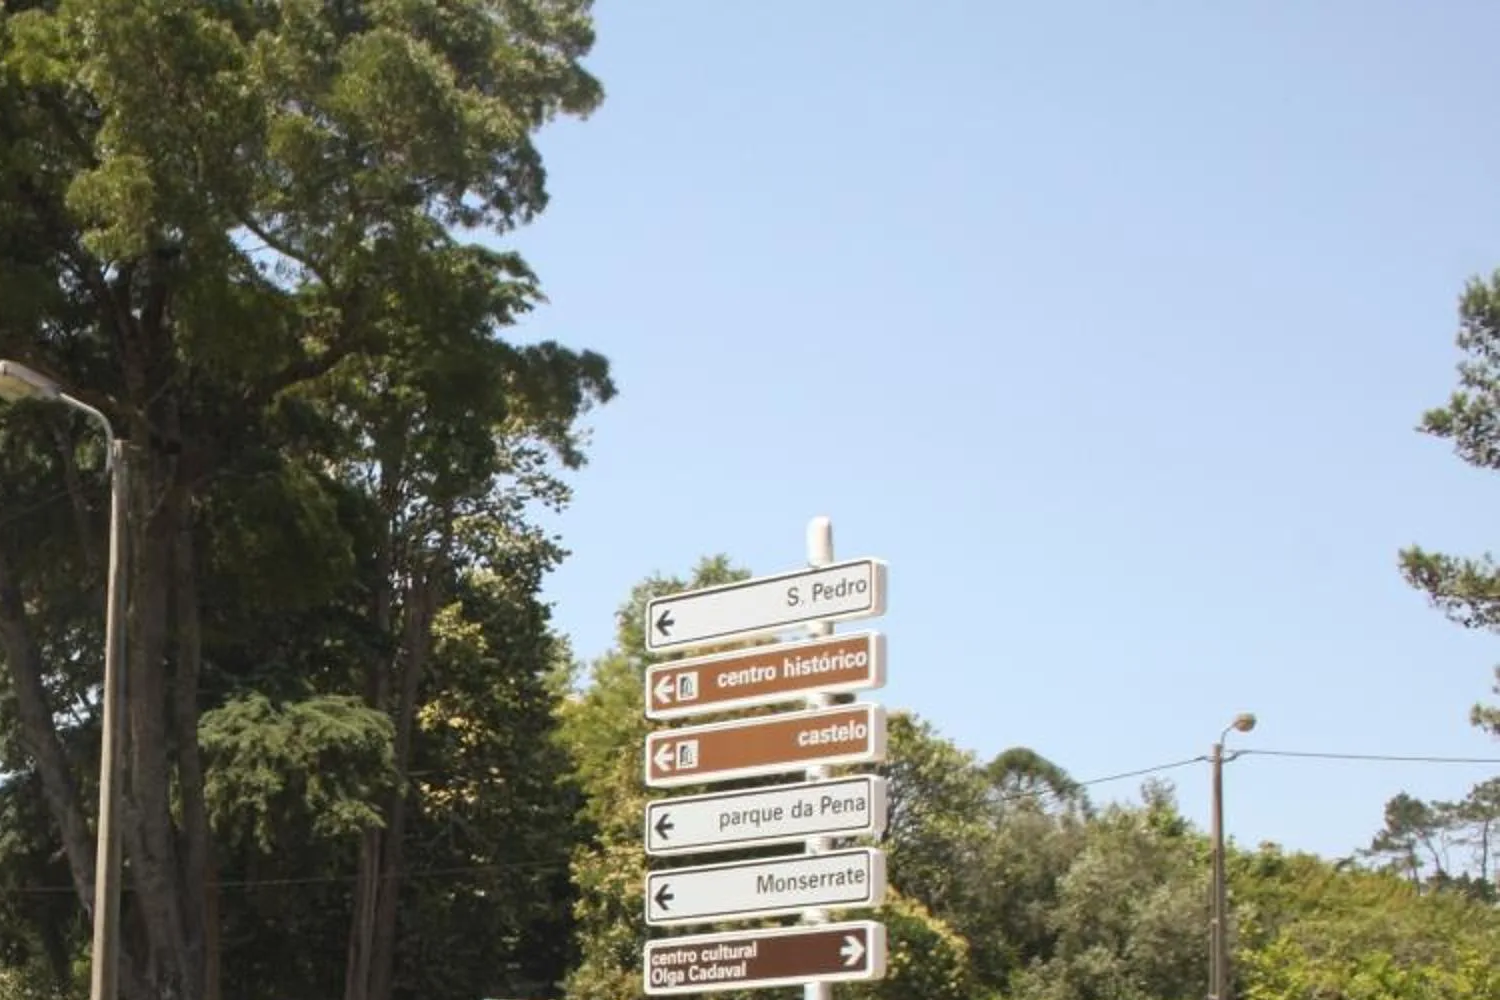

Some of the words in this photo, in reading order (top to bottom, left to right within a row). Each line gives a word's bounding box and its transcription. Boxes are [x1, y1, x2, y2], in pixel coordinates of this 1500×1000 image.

[812, 578, 867, 602] Pedro
[717, 665, 776, 688] centro
[783, 648, 867, 677] histórico
[797, 719, 867, 747] castelo
[719, 804, 783, 831] parque
[791, 799, 813, 819] da
[820, 795, 866, 815] Pena
[756, 867, 865, 894] Monserrate
[651, 948, 697, 966] centro
[701, 940, 757, 961] cultural
[651, 967, 685, 988] Olga
[688, 960, 747, 981] Cadaval
